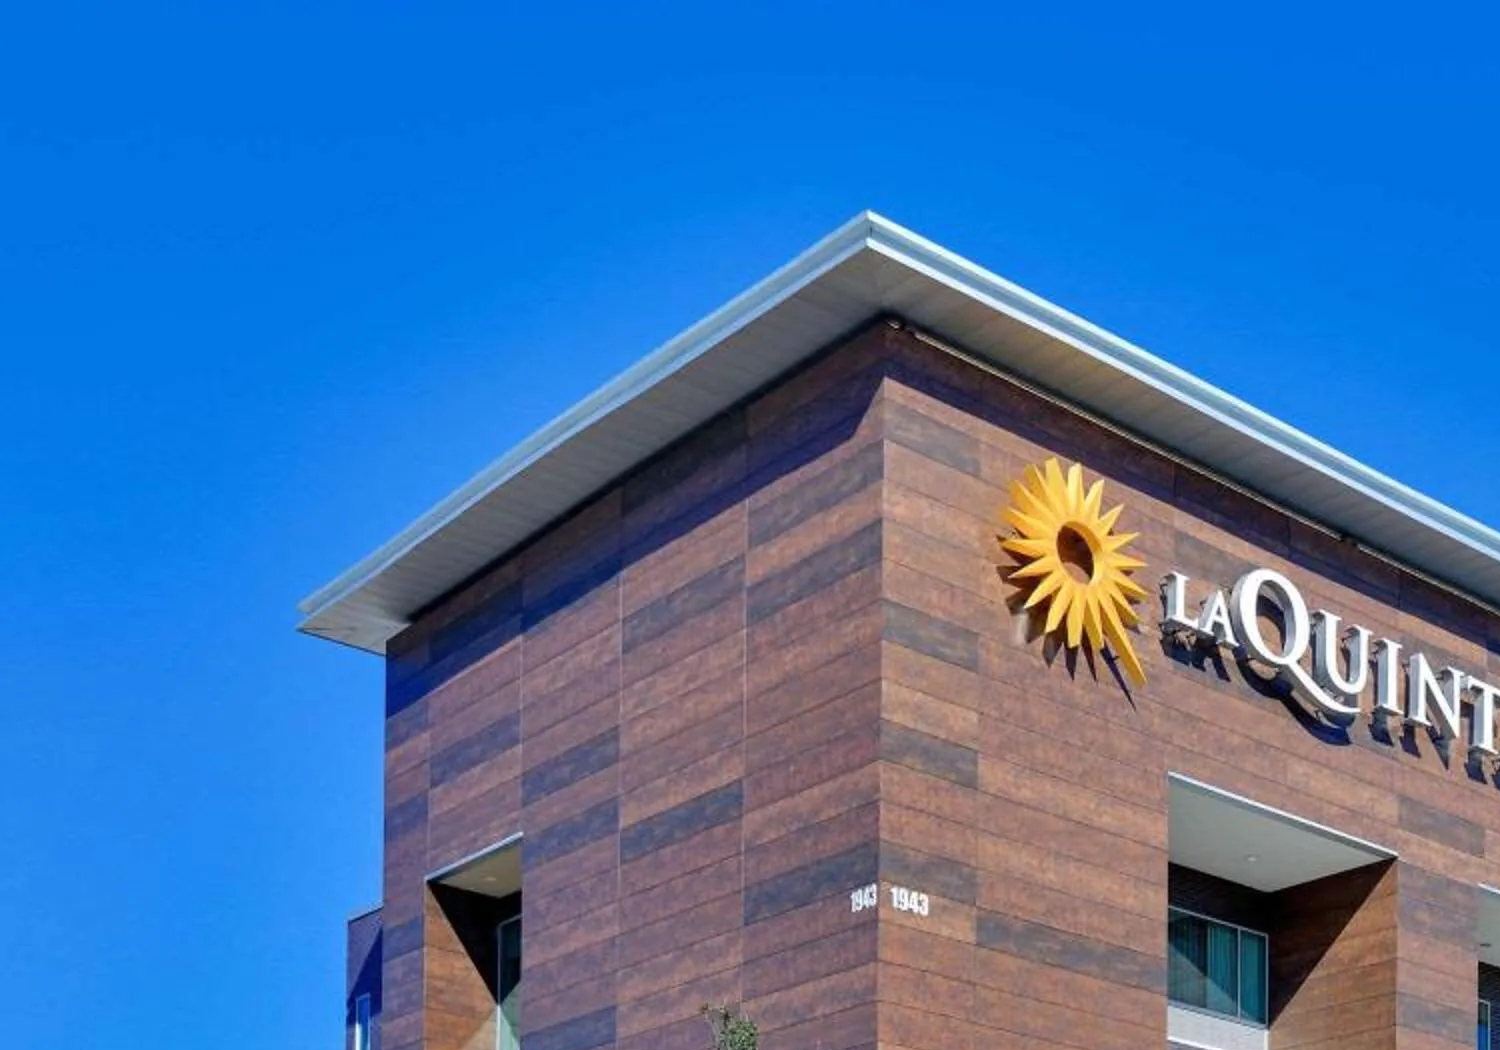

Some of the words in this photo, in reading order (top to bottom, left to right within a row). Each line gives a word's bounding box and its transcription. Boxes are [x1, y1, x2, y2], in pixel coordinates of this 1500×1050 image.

[1162, 571, 1239, 648] LA
[850, 883, 877, 912] 1943
[890, 886, 929, 916] 1943
